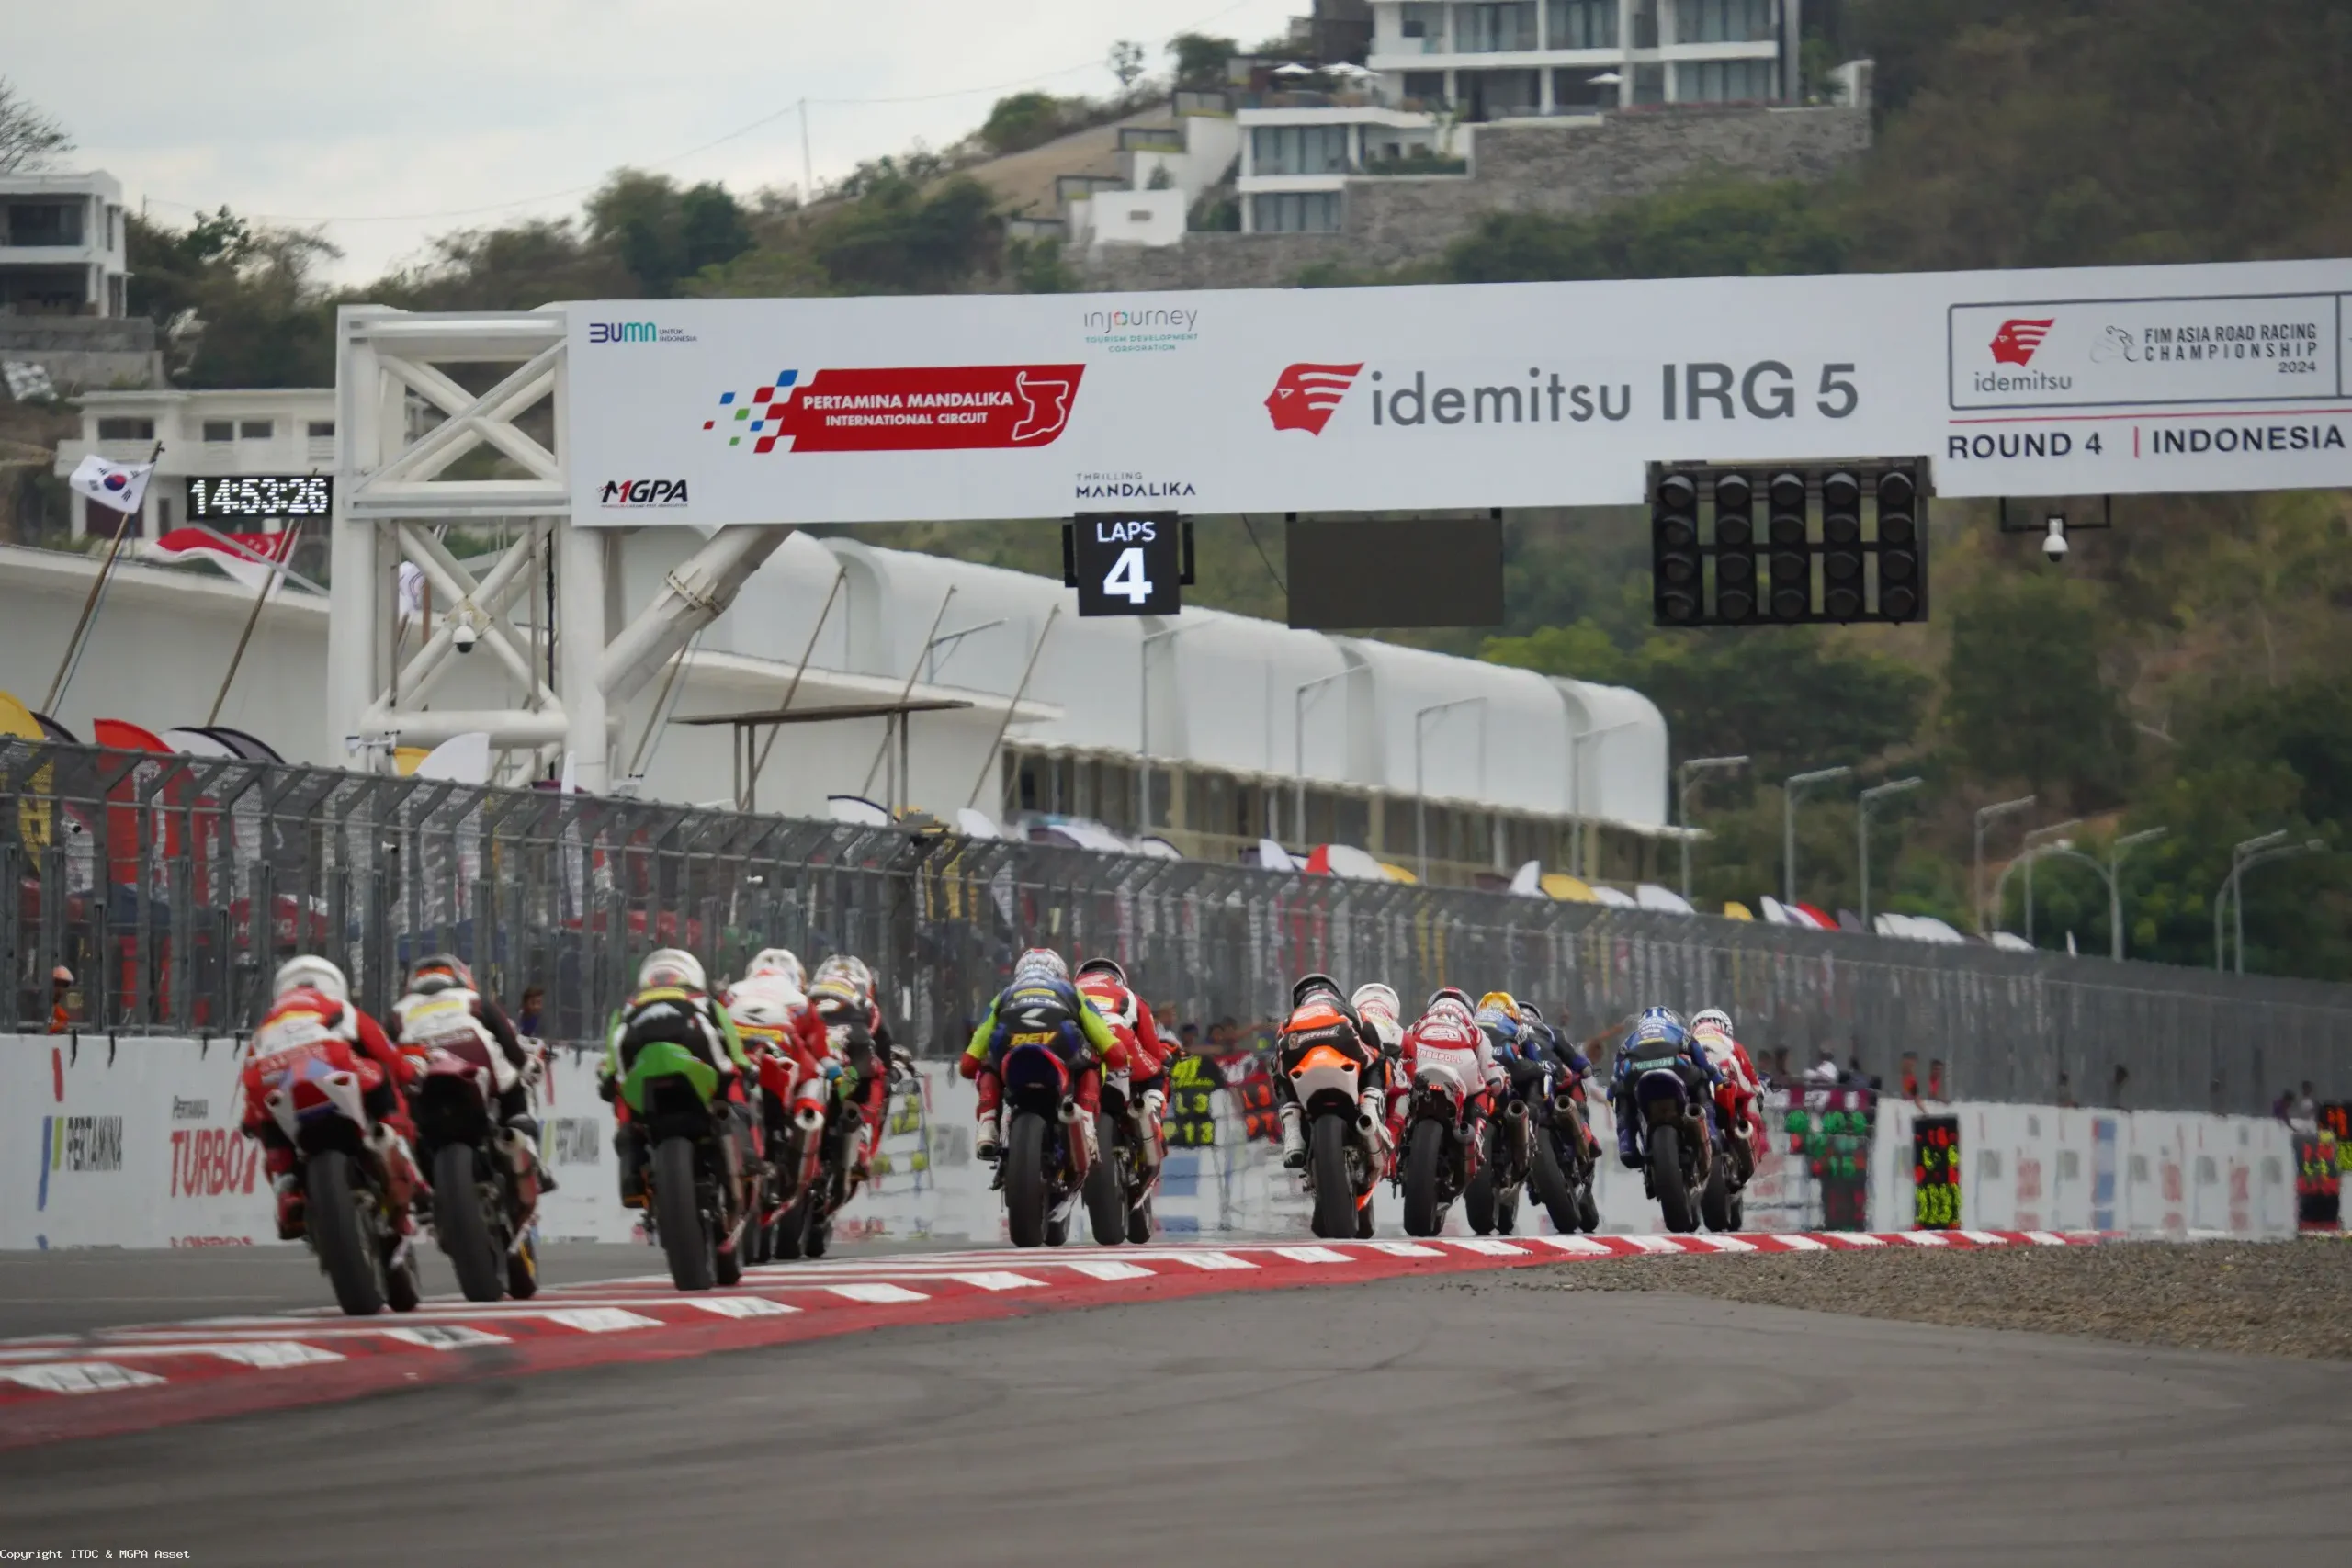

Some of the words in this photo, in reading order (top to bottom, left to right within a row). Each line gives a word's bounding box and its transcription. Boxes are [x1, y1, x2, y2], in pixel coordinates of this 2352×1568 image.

[1085, 335, 1127, 344] TOURISM
[1130, 333, 1198, 343] DEVELOPMENT
[2144, 327, 2172, 344] FIM
[2177, 325, 2210, 343] ASIA
[2215, 324, 2256, 341] ROAD
[2260, 322, 2317, 340] RACING
[1108, 344, 1176, 353] CORPORATION
[2144, 342, 2317, 362] CHAMPIONSHIP
[2278, 361, 2316, 374] 2024
[1974, 369, 2073, 392] idemitsu
[802, 394, 903, 410] PERTAMINA
[907, 391, 1014, 408] MANDALIKA
[1372, 367, 1631, 426] idemitsu
[1662, 359, 1795, 421] IRG
[1815, 363, 1859, 419] 5
[825, 413, 933, 426] INTERNATIONAL
[937, 412, 988, 424] CIRCUIT
[1948, 432, 2073, 459] ROUND
[2085, 432, 2103, 457] 4
[2153, 424, 2346, 455] INDONESIA
[1076, 471, 1143, 481] THRILLING
[190, 478, 329, 515] 14:53:26
[1076, 482, 1196, 498] MANDALIKA
[1097, 521, 1157, 543] LAPS
[1103, 547, 1153, 604] 4
